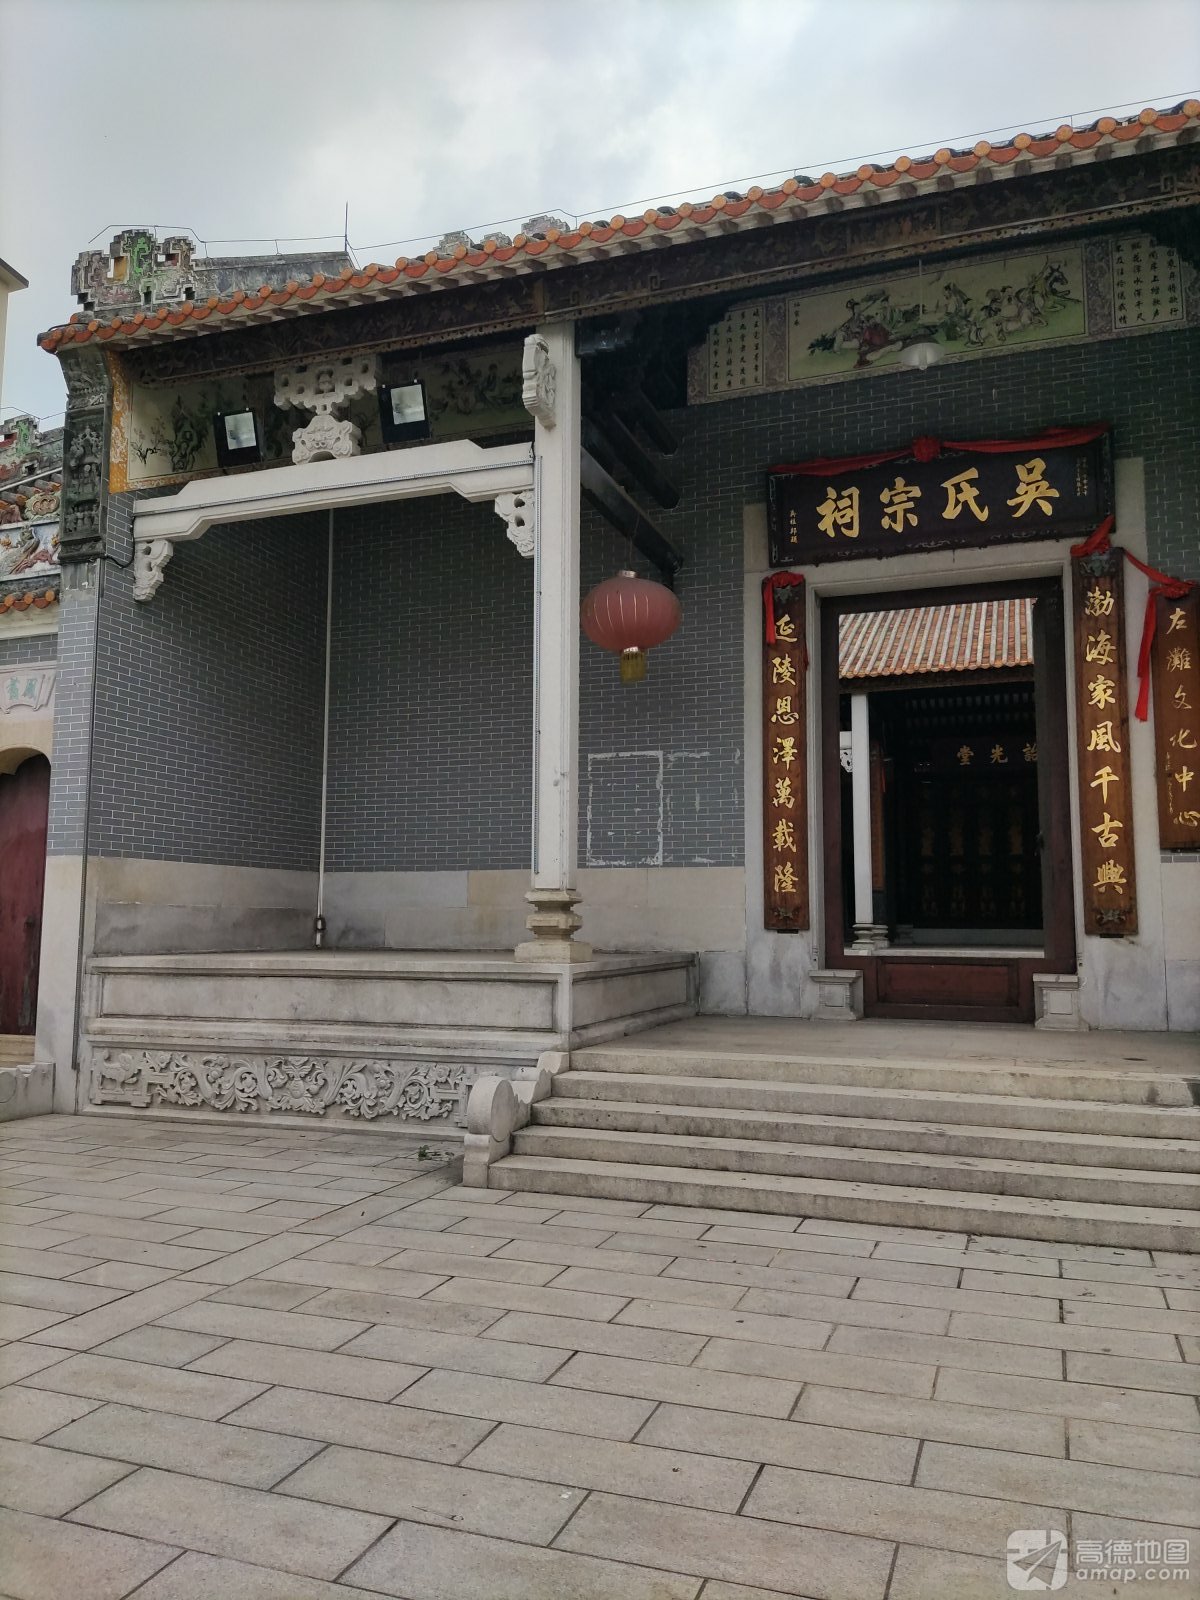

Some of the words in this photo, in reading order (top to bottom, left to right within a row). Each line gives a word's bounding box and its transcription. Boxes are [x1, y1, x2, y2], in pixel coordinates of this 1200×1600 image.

[816, 458, 1060, 538] 吳氏宗祠
[769, 614, 800, 894] 延陵恩澤萬載隆
[1084, 586, 1127, 895] 渤海家風千古興
[1166, 607, 1200, 828] 左灘文化中心
